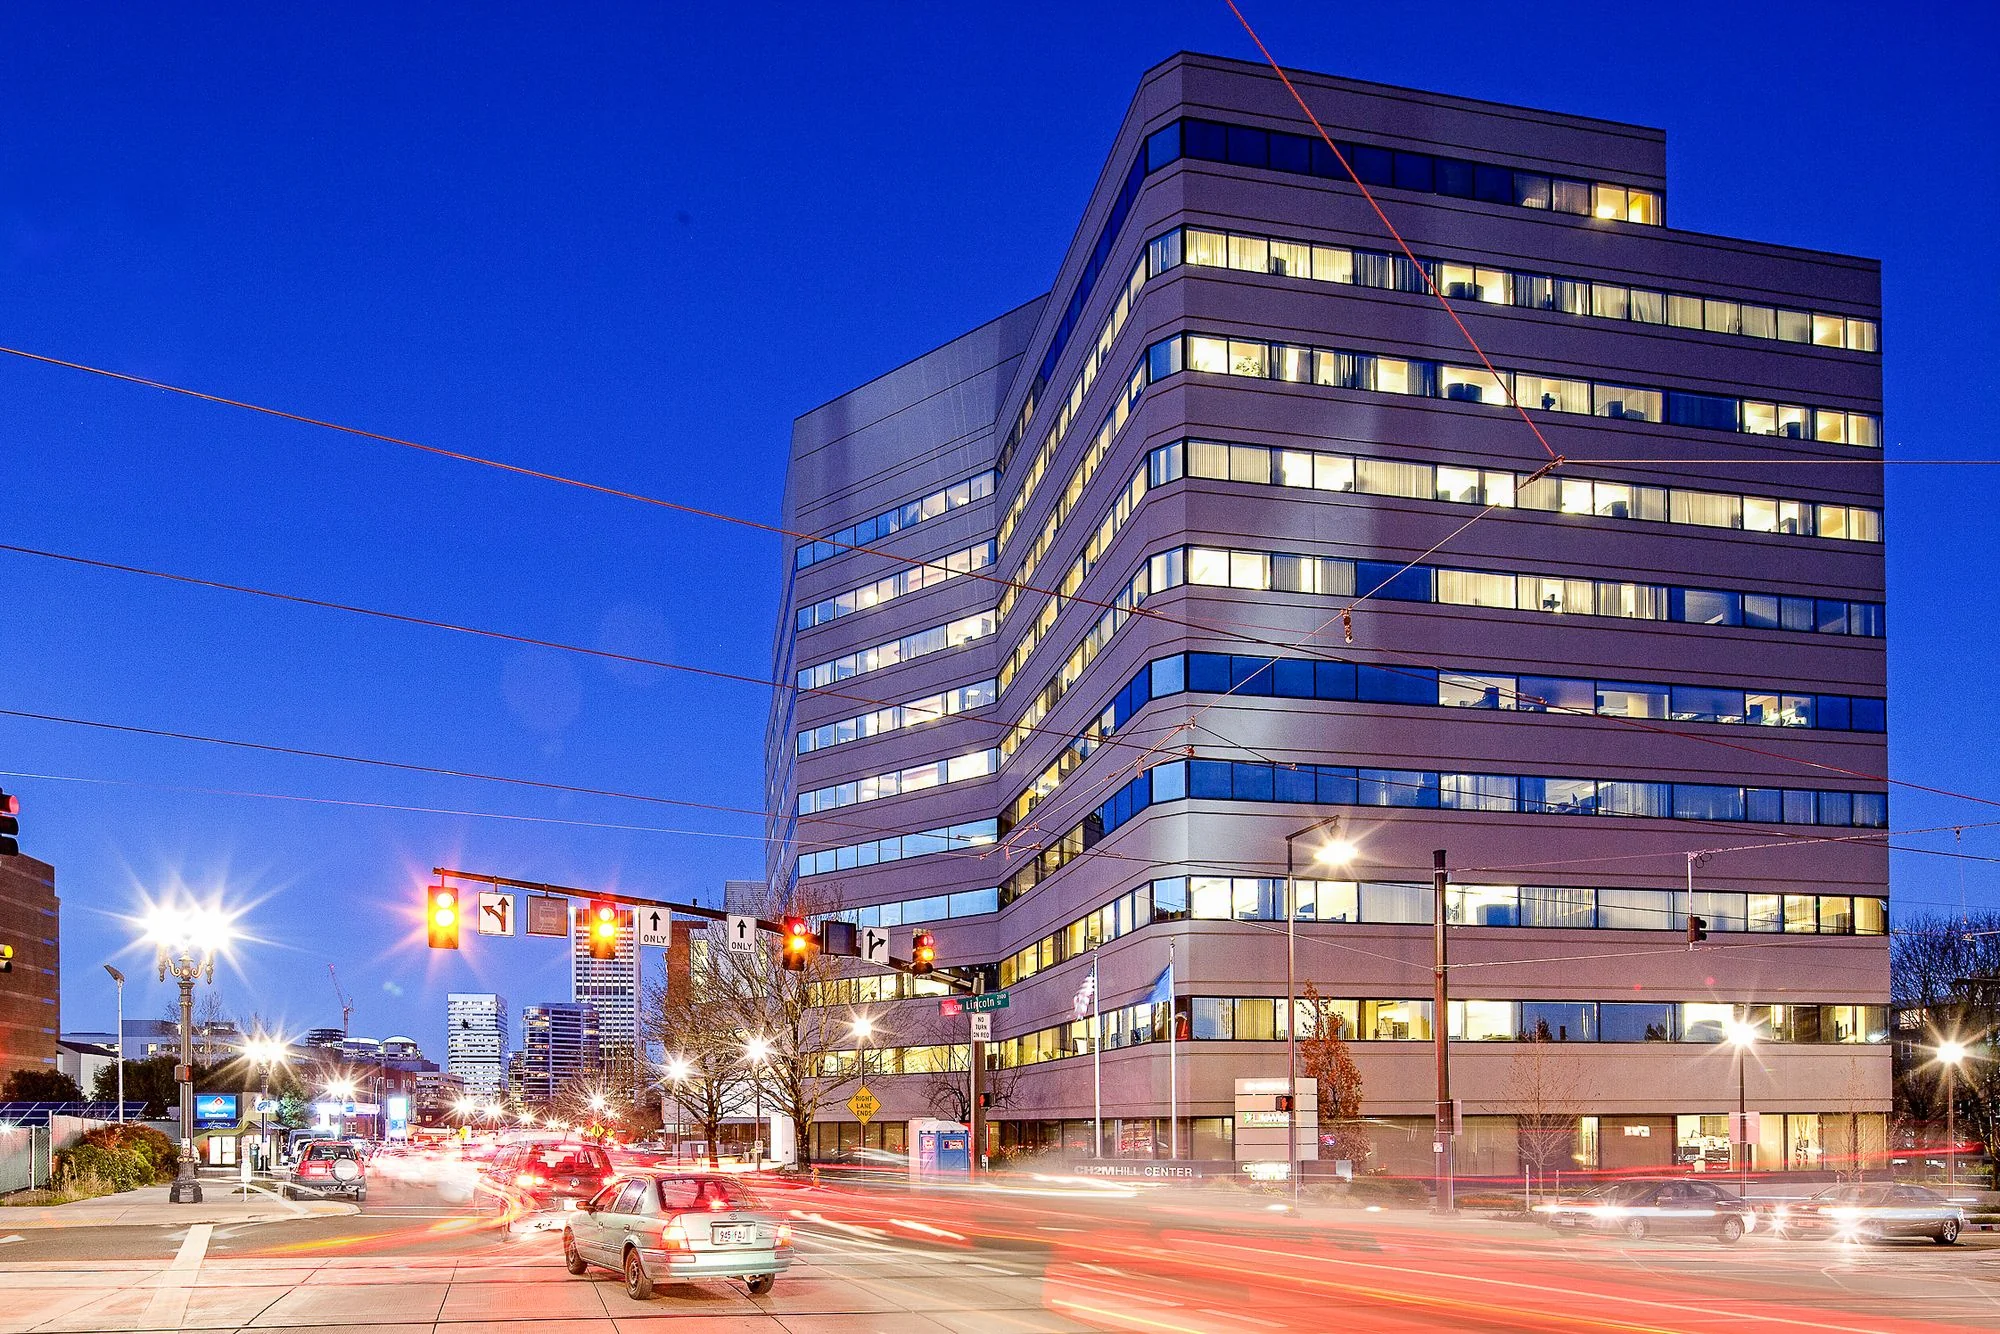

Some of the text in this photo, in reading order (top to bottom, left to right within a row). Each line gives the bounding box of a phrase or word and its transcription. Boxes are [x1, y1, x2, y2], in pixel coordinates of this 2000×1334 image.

[644, 934, 667, 944] ONLY
[731, 941, 753, 951] ONLY
[966, 998, 995, 1010] Lincoln
[1144, 1166, 1193, 1177] CENTER
